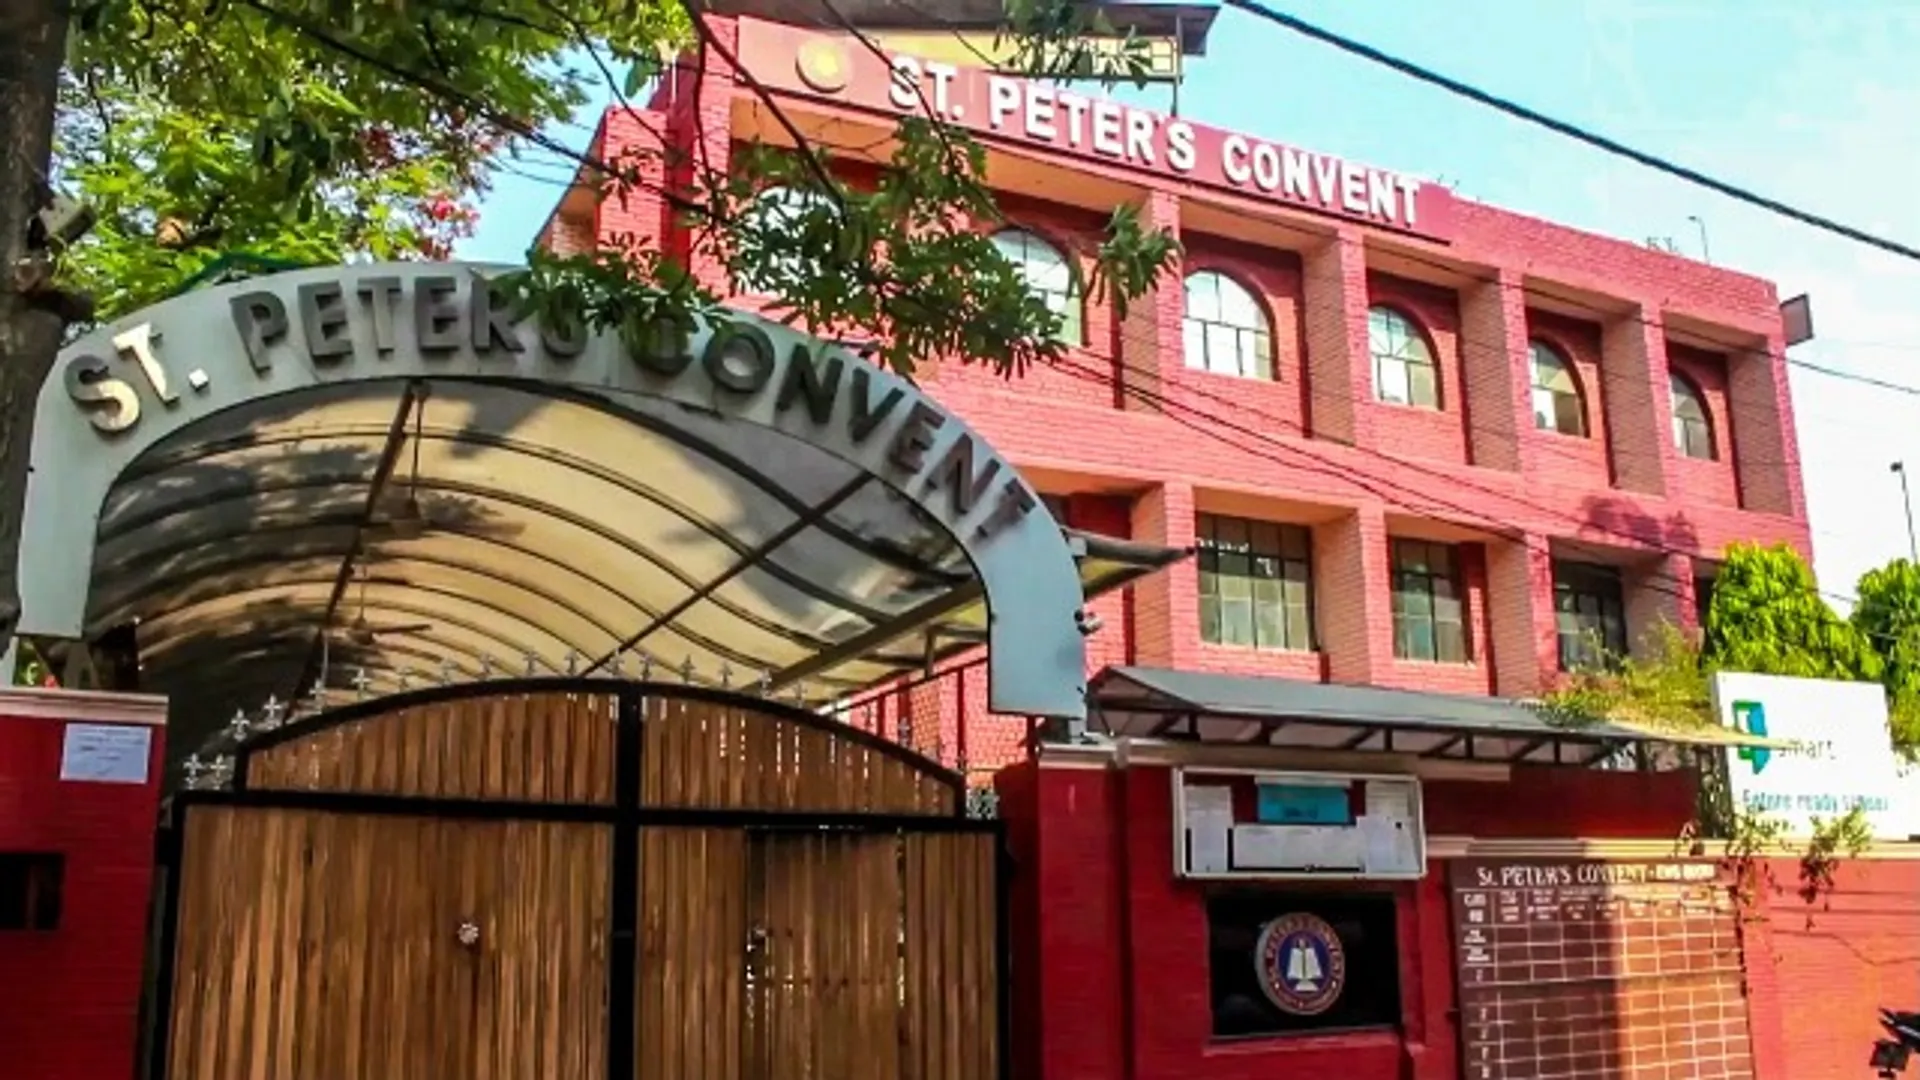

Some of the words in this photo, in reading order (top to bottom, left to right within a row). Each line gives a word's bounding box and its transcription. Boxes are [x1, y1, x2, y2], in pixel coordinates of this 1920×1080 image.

[889, 55, 965, 120] ST.
[987, 73, 1196, 172] PETER'S
[1221, 134, 1420, 226] CONVENT
[64, 321, 210, 434] ST.
